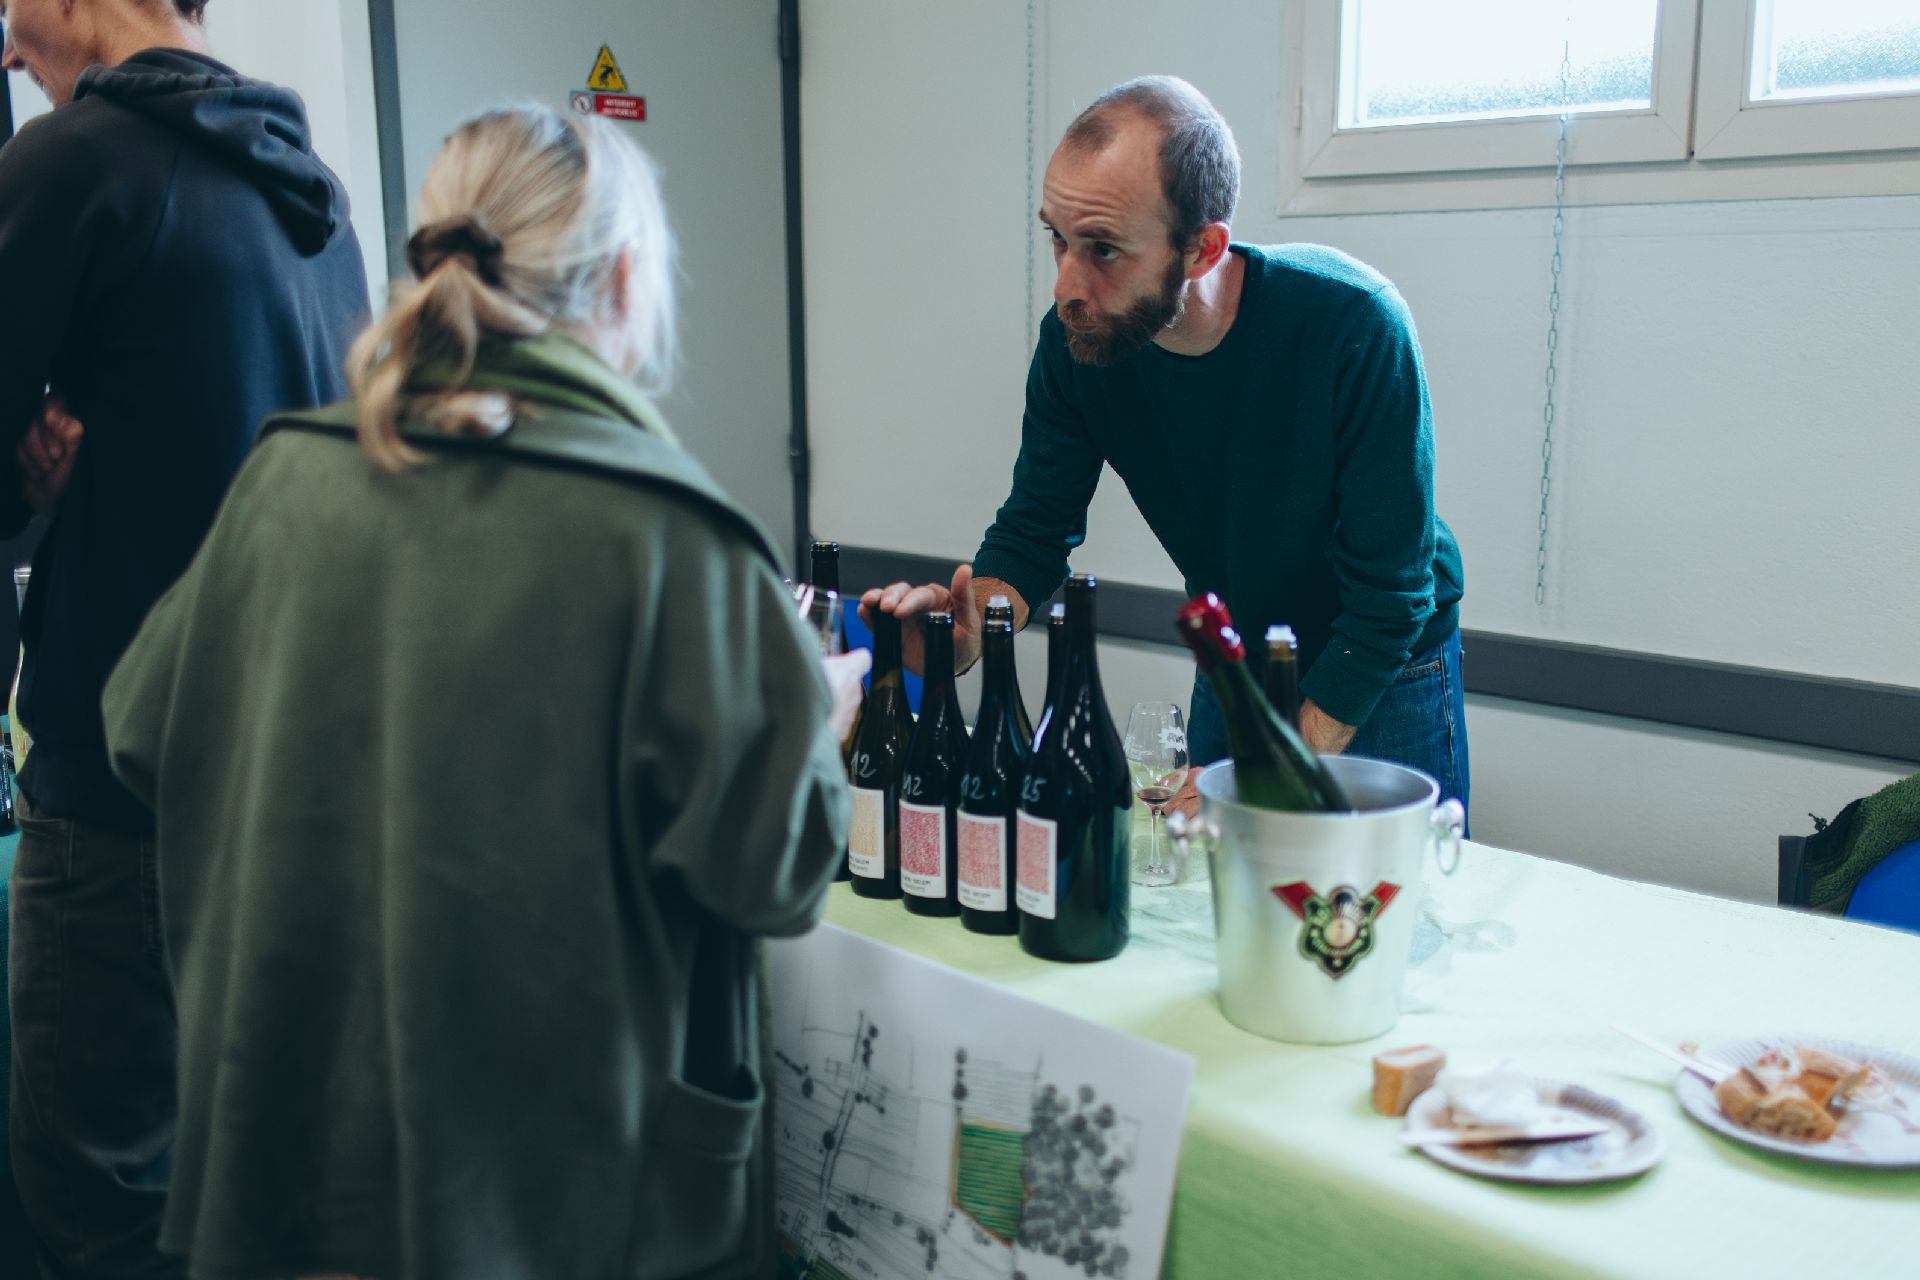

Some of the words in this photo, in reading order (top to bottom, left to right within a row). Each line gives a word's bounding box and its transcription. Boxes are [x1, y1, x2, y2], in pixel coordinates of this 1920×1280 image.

[850, 751, 877, 778] 12
[902, 772, 923, 796] 12
[960, 773, 985, 800] 12
